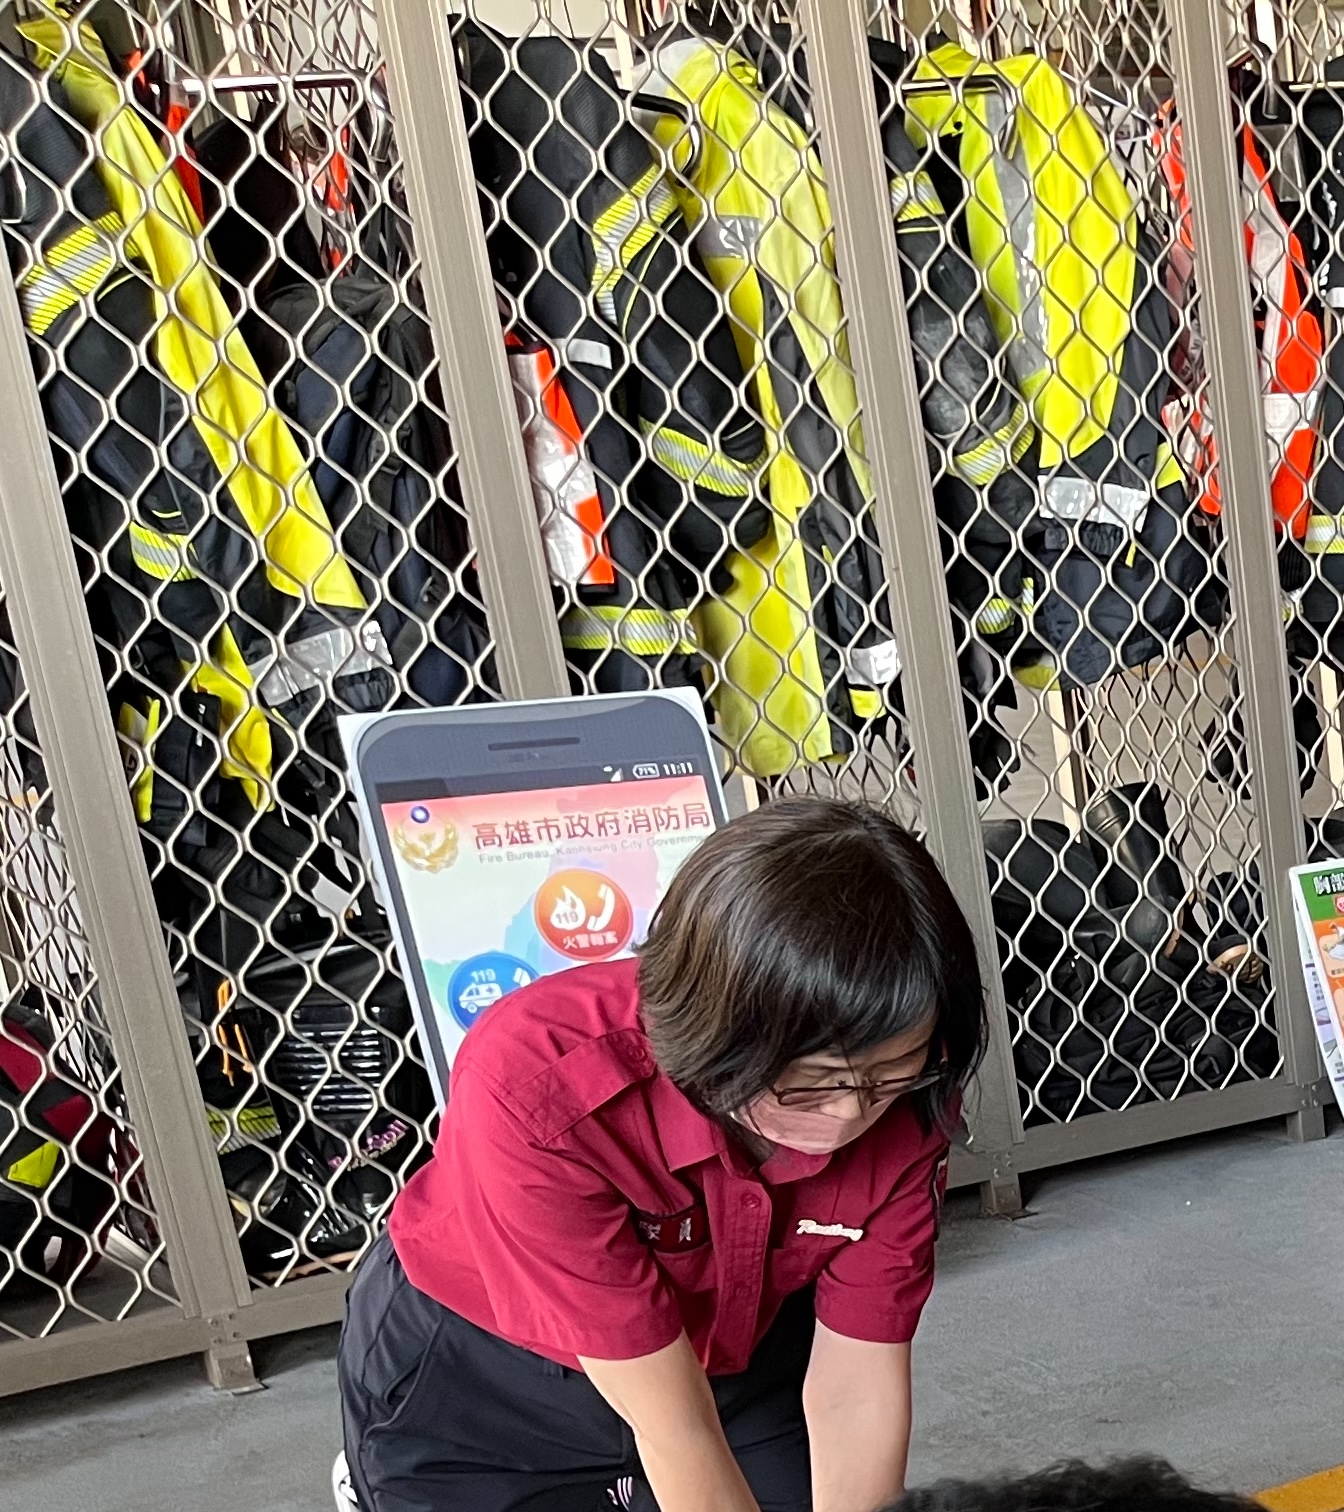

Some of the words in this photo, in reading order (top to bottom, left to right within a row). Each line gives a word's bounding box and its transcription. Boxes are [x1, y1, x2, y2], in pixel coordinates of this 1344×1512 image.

[472, 802, 711, 850] 高雄市政府消防局
[555, 910, 579, 925] 119
[470, 967, 496, 983] 119
